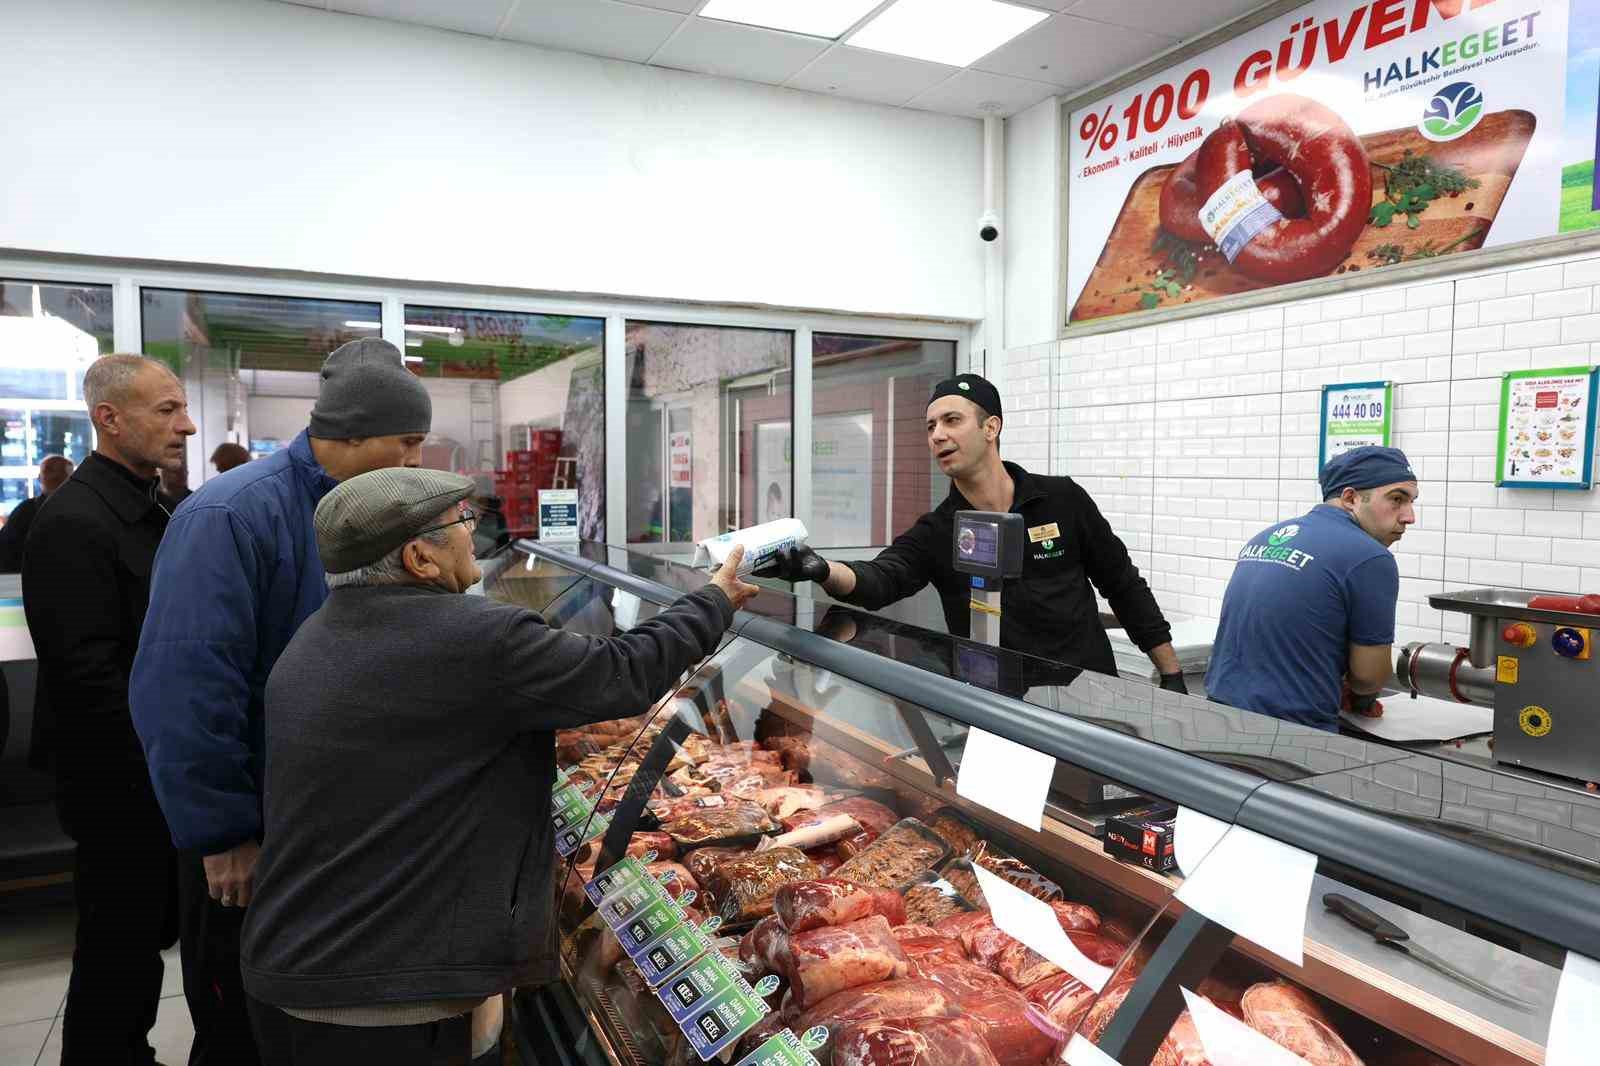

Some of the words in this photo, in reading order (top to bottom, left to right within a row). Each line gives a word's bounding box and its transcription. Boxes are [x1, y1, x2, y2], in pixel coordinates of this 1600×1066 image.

[1363, 10, 1541, 92] HALKEGEET
[1443, 58, 1483, 78] Belediyesi
[1080, 68, 1210, 159] %100
[1233, 0, 1497, 97] GÜVEN
[1083, 157, 1120, 178] Ekonomik
[1129, 141, 1158, 161] Kaliteli
[1167, 126, 1204, 149] Hijyenik
[1332, 404, 1351, 420] 444
[1353, 403, 1367, 419] 40
[1369, 402, 1383, 418] 09
[729, 998, 747, 1016] DANA
